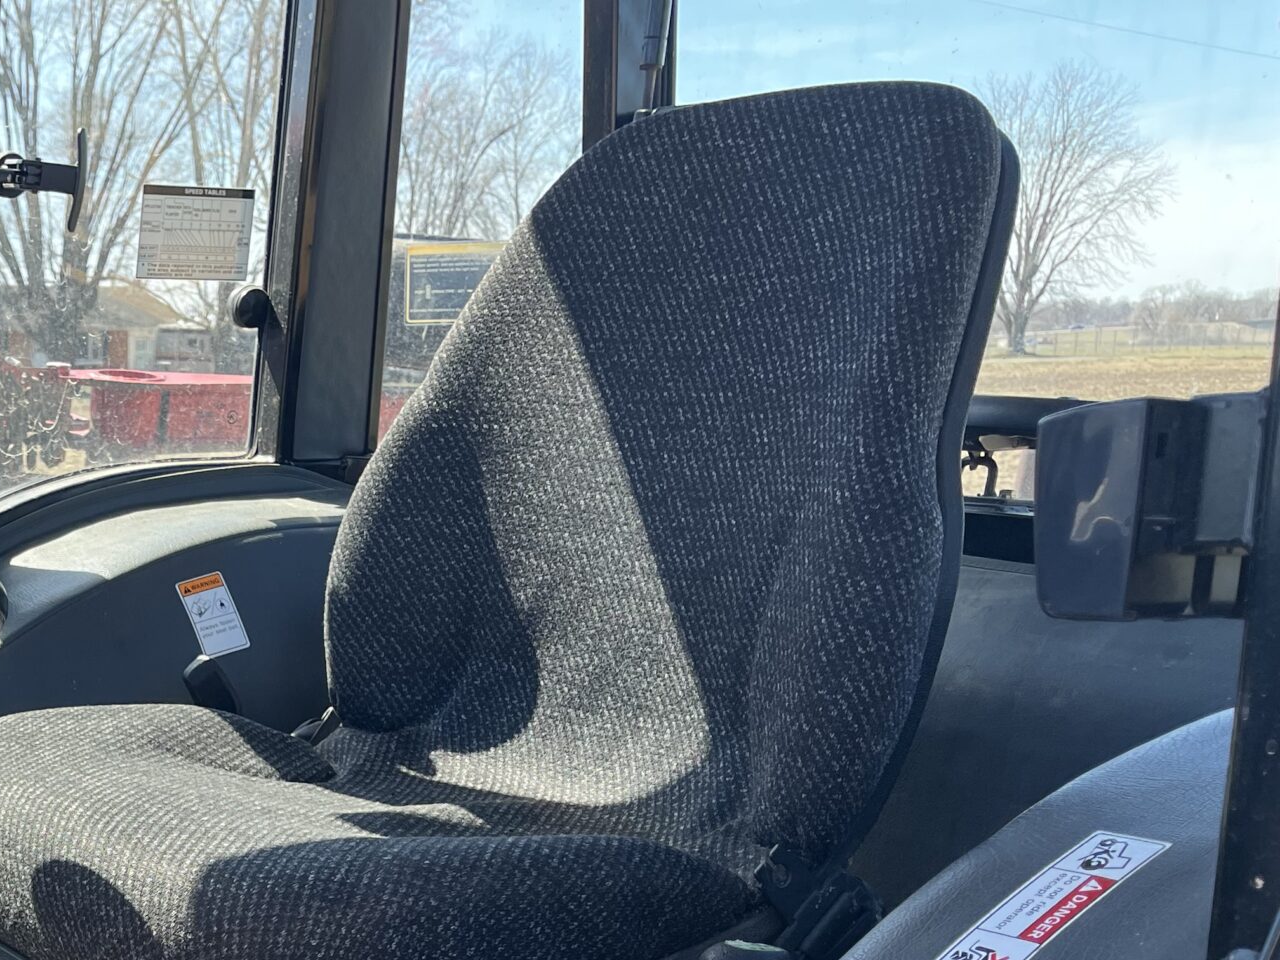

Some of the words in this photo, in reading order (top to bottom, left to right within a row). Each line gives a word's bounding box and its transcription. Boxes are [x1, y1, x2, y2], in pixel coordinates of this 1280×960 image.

[191, 577, 220, 590] WARNING
[1034, 872, 1069, 899] except
[1063, 874, 1081, 886] Do
[1046, 886, 1065, 900] not
[995, 898, 1036, 931] operator
[1025, 901, 1048, 917] ride
[1026, 893, 1089, 940] DANGER
